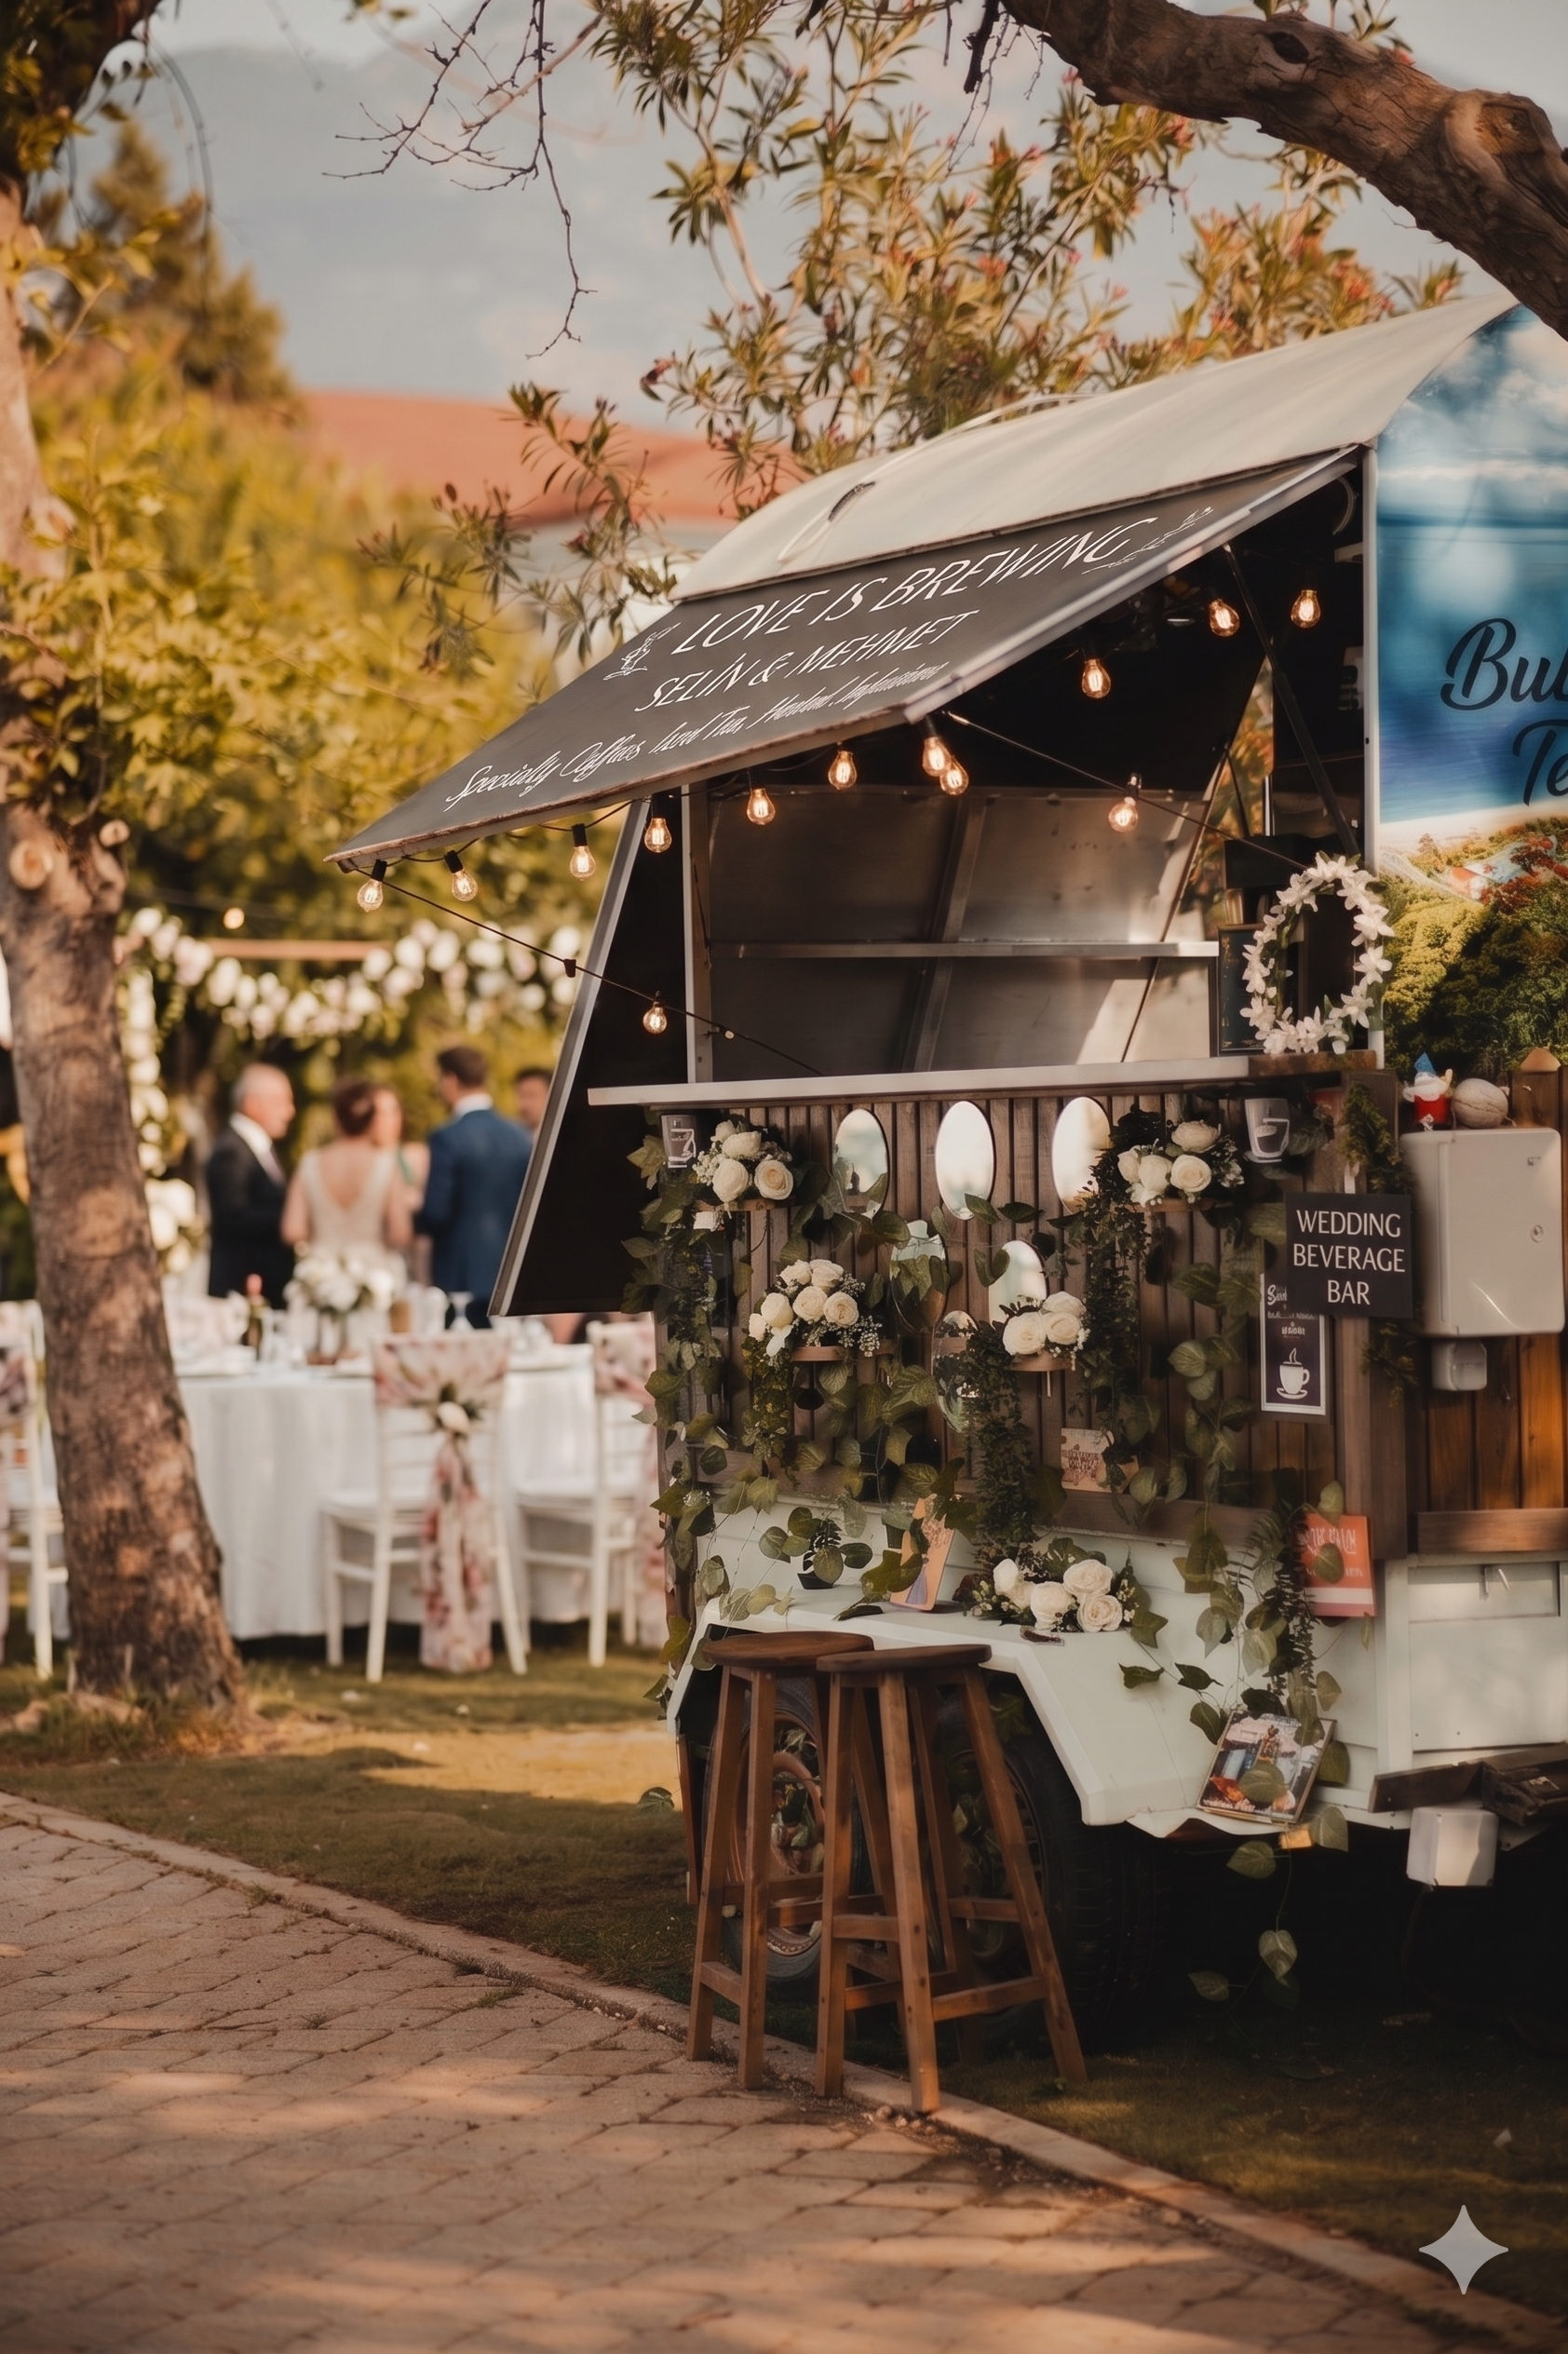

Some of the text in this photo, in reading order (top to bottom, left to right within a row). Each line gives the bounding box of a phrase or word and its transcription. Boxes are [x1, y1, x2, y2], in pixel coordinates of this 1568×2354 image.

[670, 517, 1158, 656] LOVE IS BREWING
[748, 651, 795, 686] &
[783, 609, 981, 680] MEHMET
[1295, 1210, 1401, 1238] WEDDING
[1292, 1243, 1406, 1273] BEVERAGE
[1327, 1279, 1371, 1306] BAR
